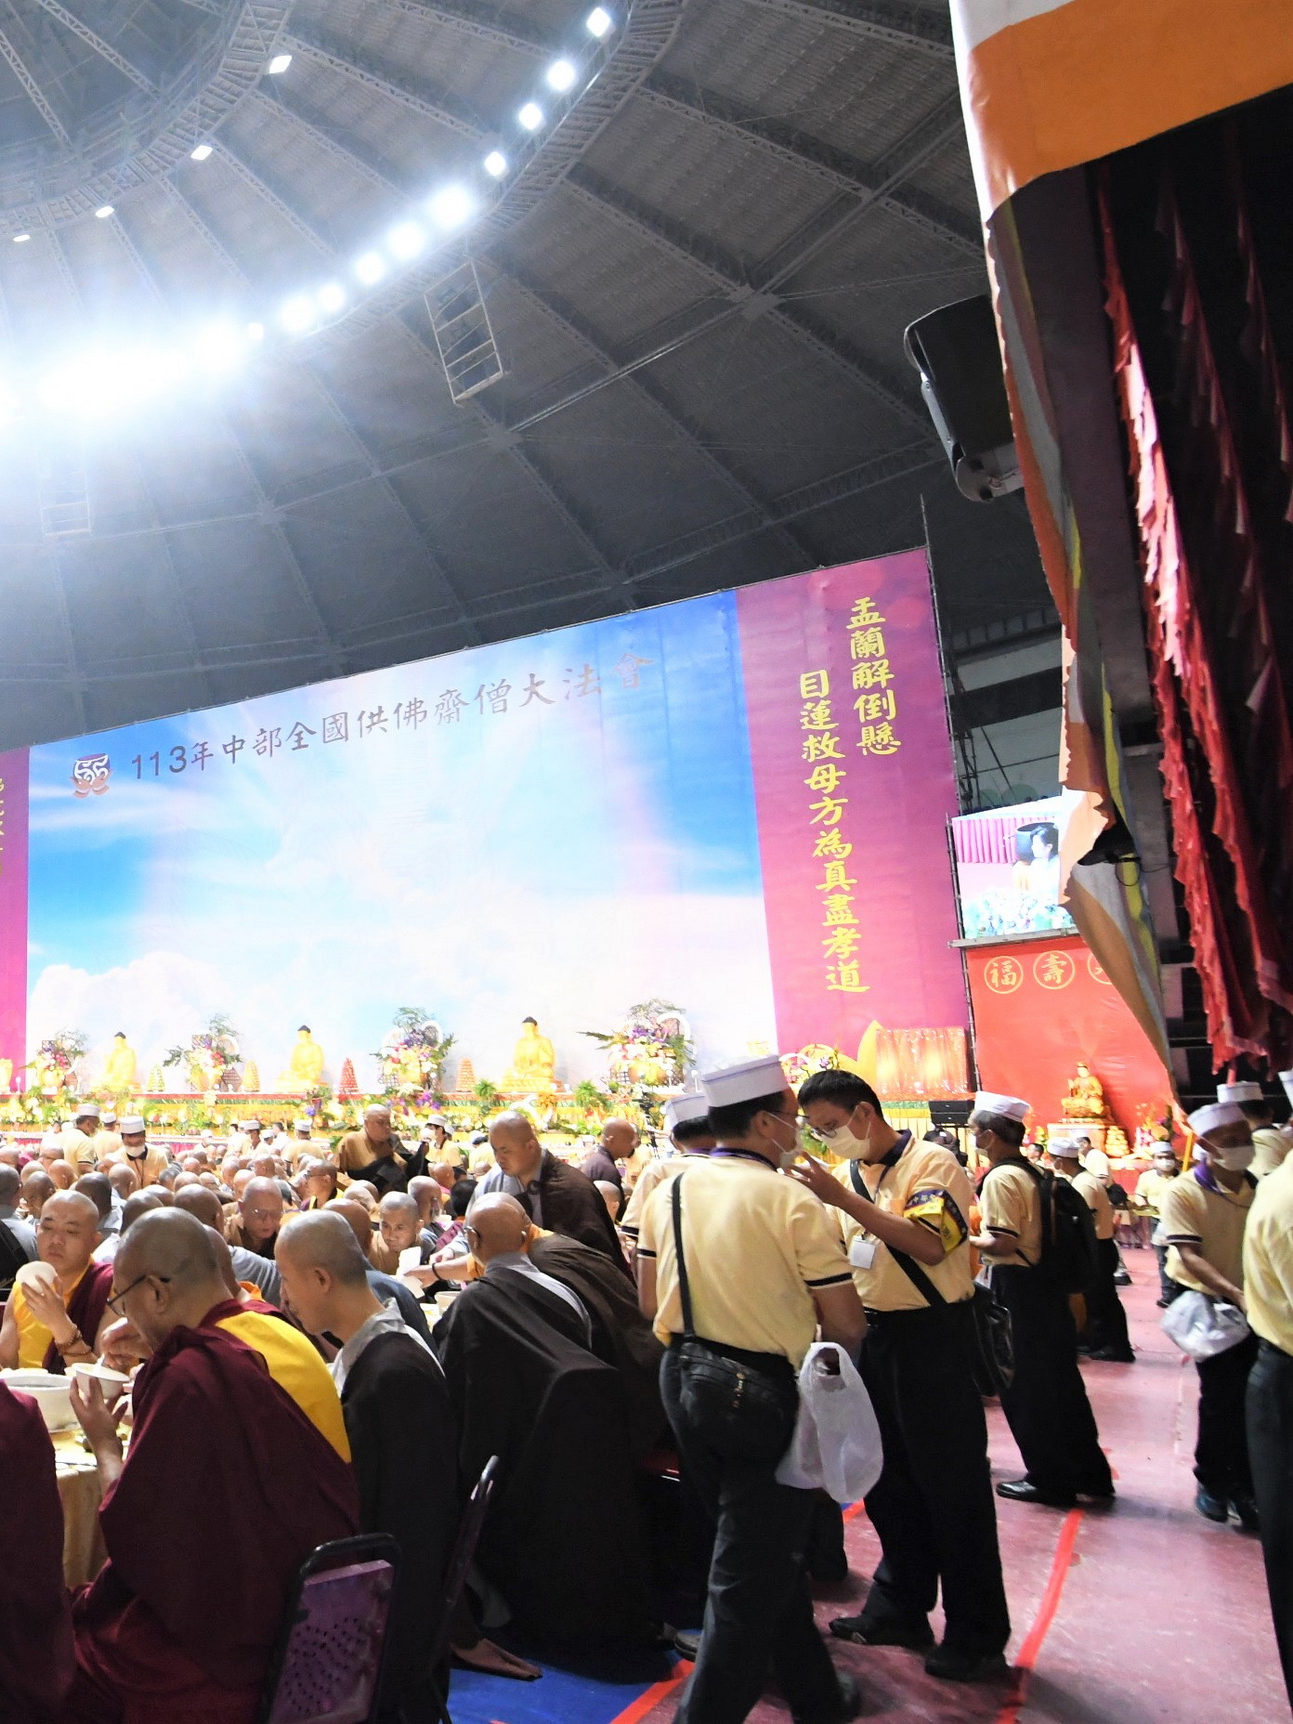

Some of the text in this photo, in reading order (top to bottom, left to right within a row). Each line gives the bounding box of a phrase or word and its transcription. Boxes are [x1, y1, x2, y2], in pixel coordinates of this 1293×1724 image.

[845, 596, 902, 756] 盂蘭解倒懸
[799, 669, 871, 993] 目蓮救母方為真盡孝道
